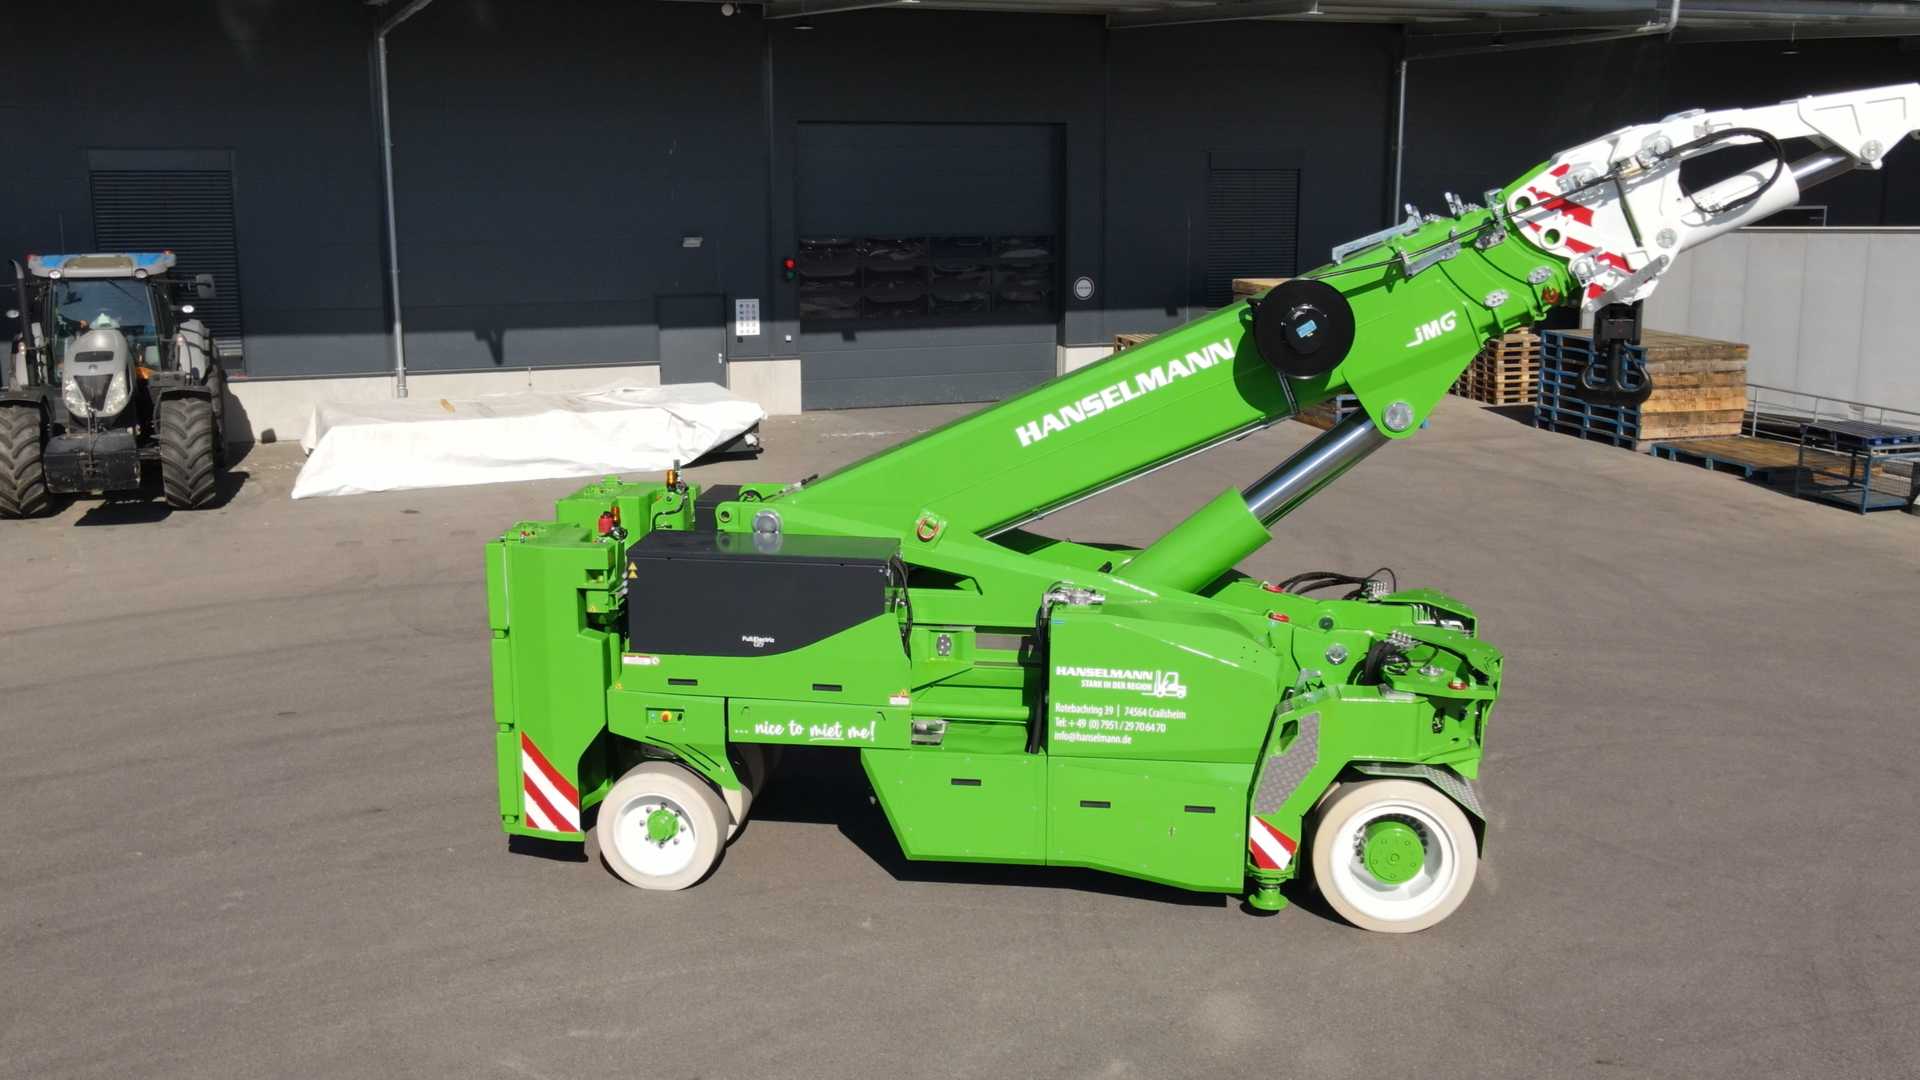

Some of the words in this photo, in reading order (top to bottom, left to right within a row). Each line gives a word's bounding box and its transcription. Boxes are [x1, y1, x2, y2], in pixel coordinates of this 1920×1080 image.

[1015, 338, 1235, 448] HANSELMANN
[1055, 666, 1153, 680] HANSELMANN
[1081, 679, 1103, 689] STARK
[1127, 682, 1152, 691] REGION
[1055, 702, 1103, 717] Rotebachring
[1124, 706, 1147, 718] 74564
[1148, 707, 1186, 720] Crailsheim
[754, 721, 784, 736] nice
[787, 720, 804, 736] to
[809, 721, 843, 738] miet
[847, 721, 876, 742] me!
[1076, 718, 1087, 728] 49
